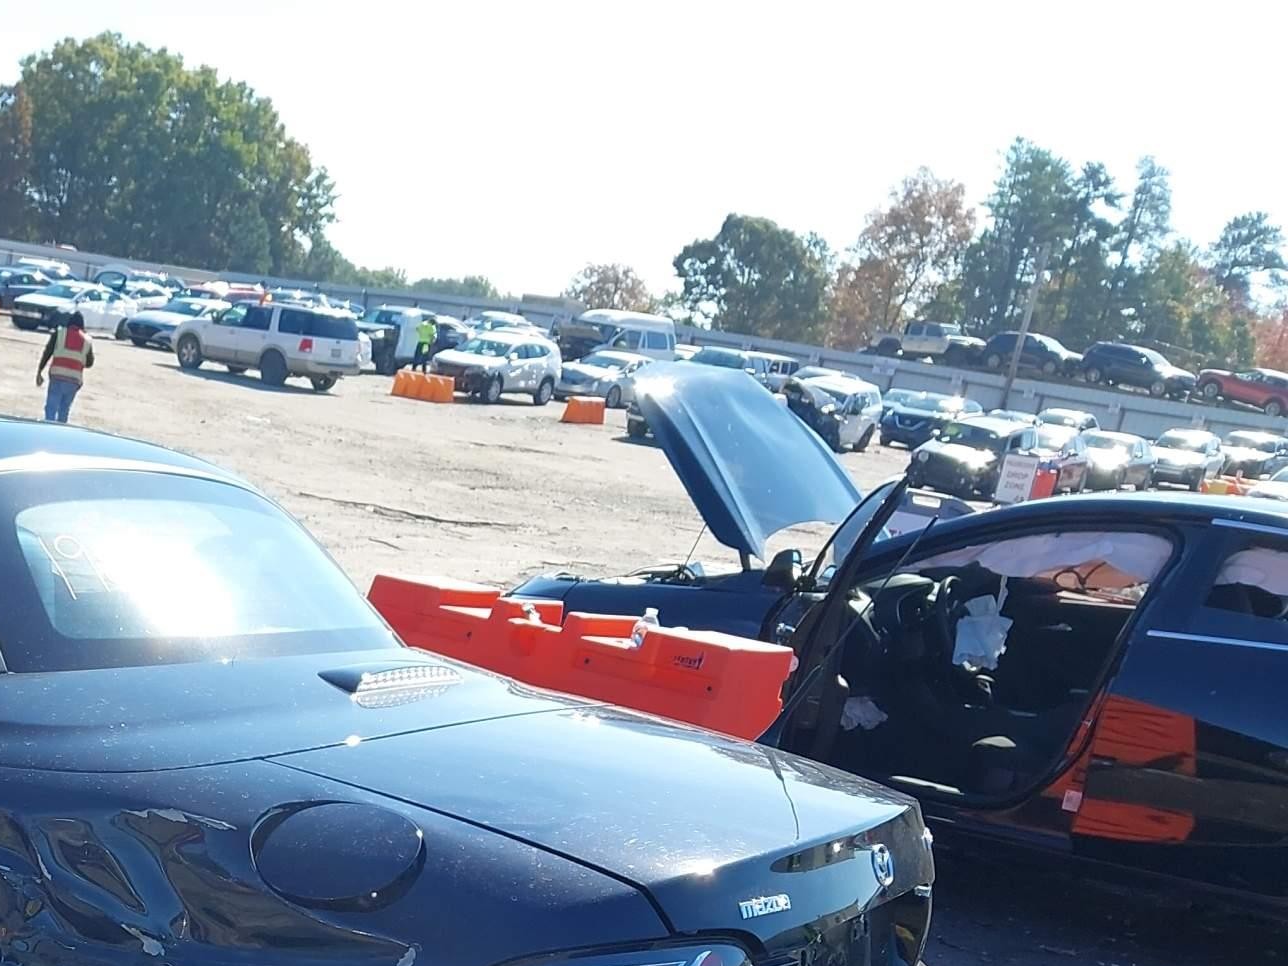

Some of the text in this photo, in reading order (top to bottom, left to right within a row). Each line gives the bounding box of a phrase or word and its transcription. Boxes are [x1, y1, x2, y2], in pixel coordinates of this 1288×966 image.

[1006, 470, 1029, 480] DROP
[1003, 480, 1025, 491] ZONE
[738, 893, 791, 920] mazda
